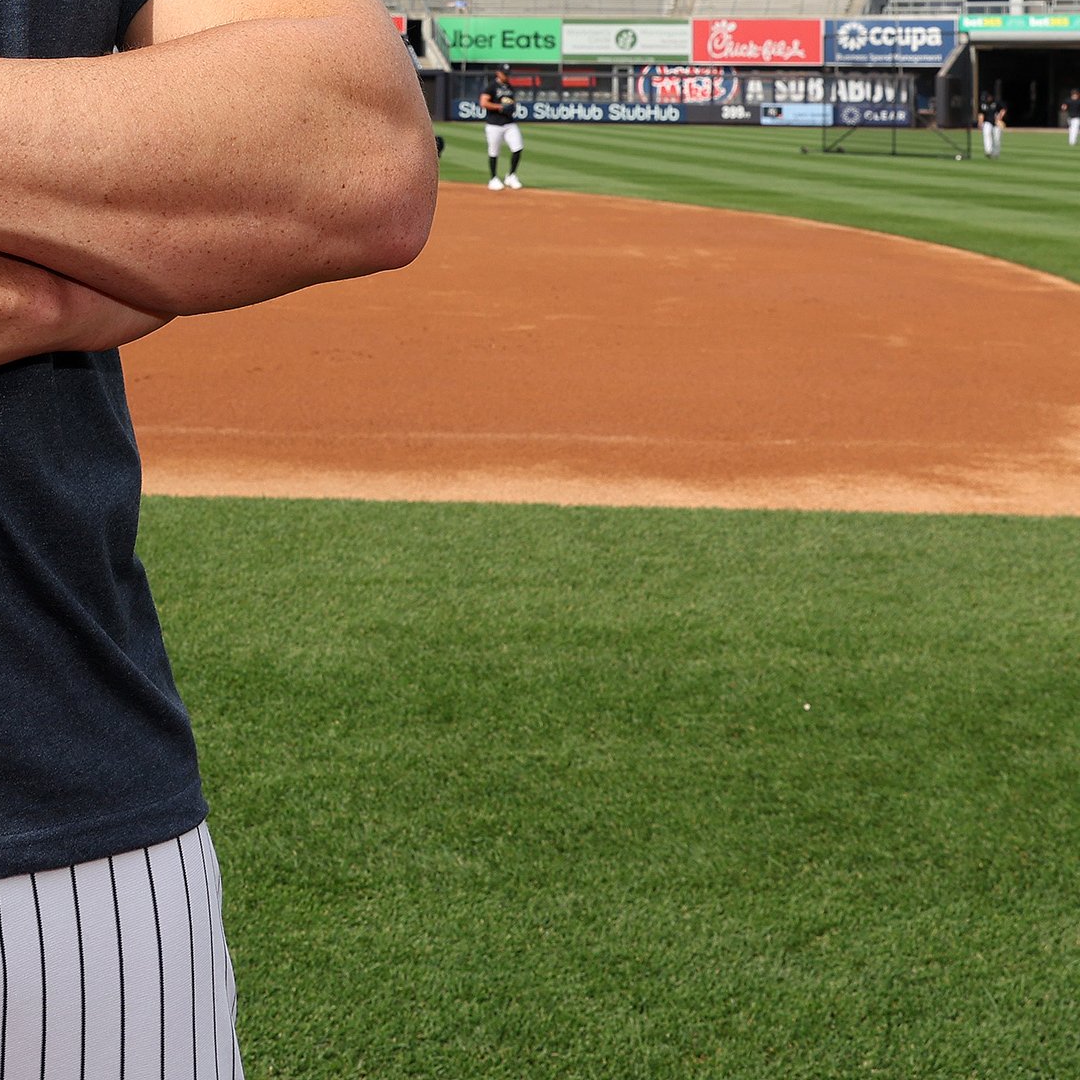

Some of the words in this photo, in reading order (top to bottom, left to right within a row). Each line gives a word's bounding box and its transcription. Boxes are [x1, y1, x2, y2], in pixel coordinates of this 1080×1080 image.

[501, 30, 556, 49] Eats
[458, 101, 528, 119] Stub
[533, 102, 604, 120] StubHub
[608, 103, 681, 121] StubHub
